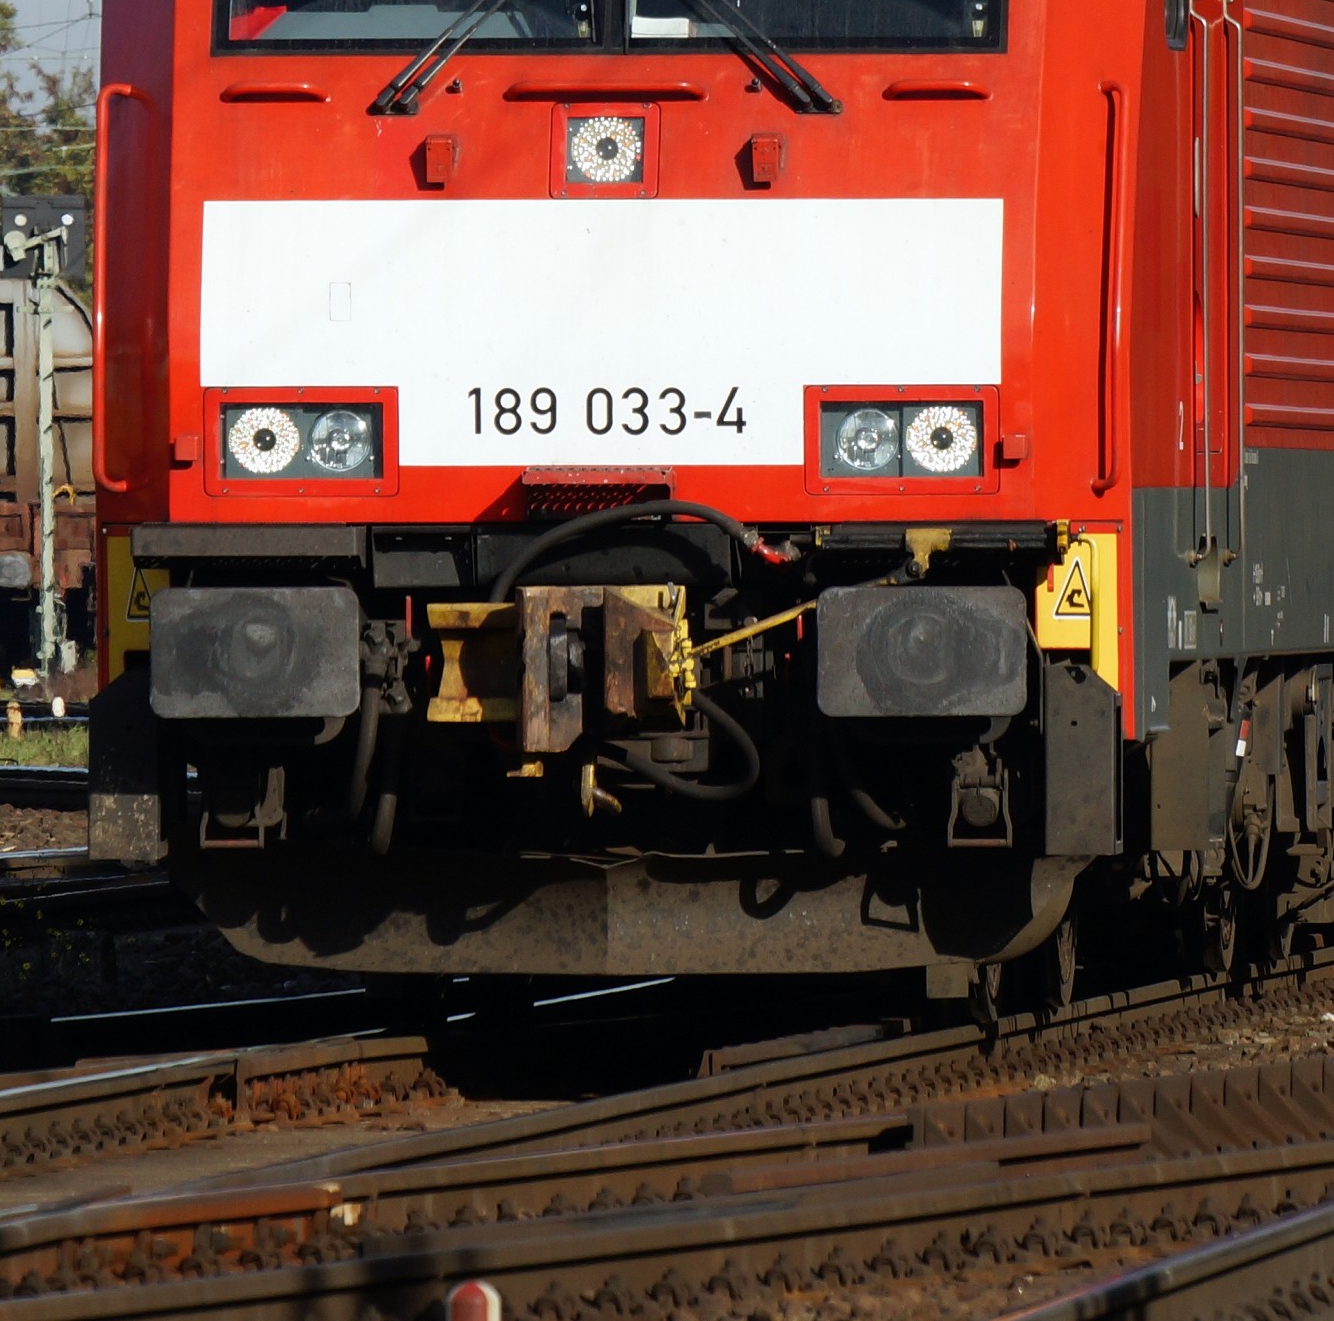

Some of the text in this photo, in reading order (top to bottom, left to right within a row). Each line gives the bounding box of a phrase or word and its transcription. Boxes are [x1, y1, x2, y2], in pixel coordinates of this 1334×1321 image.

[468, 386, 747, 435] 189 033-4
[1178, 400, 1184, 451] 2
